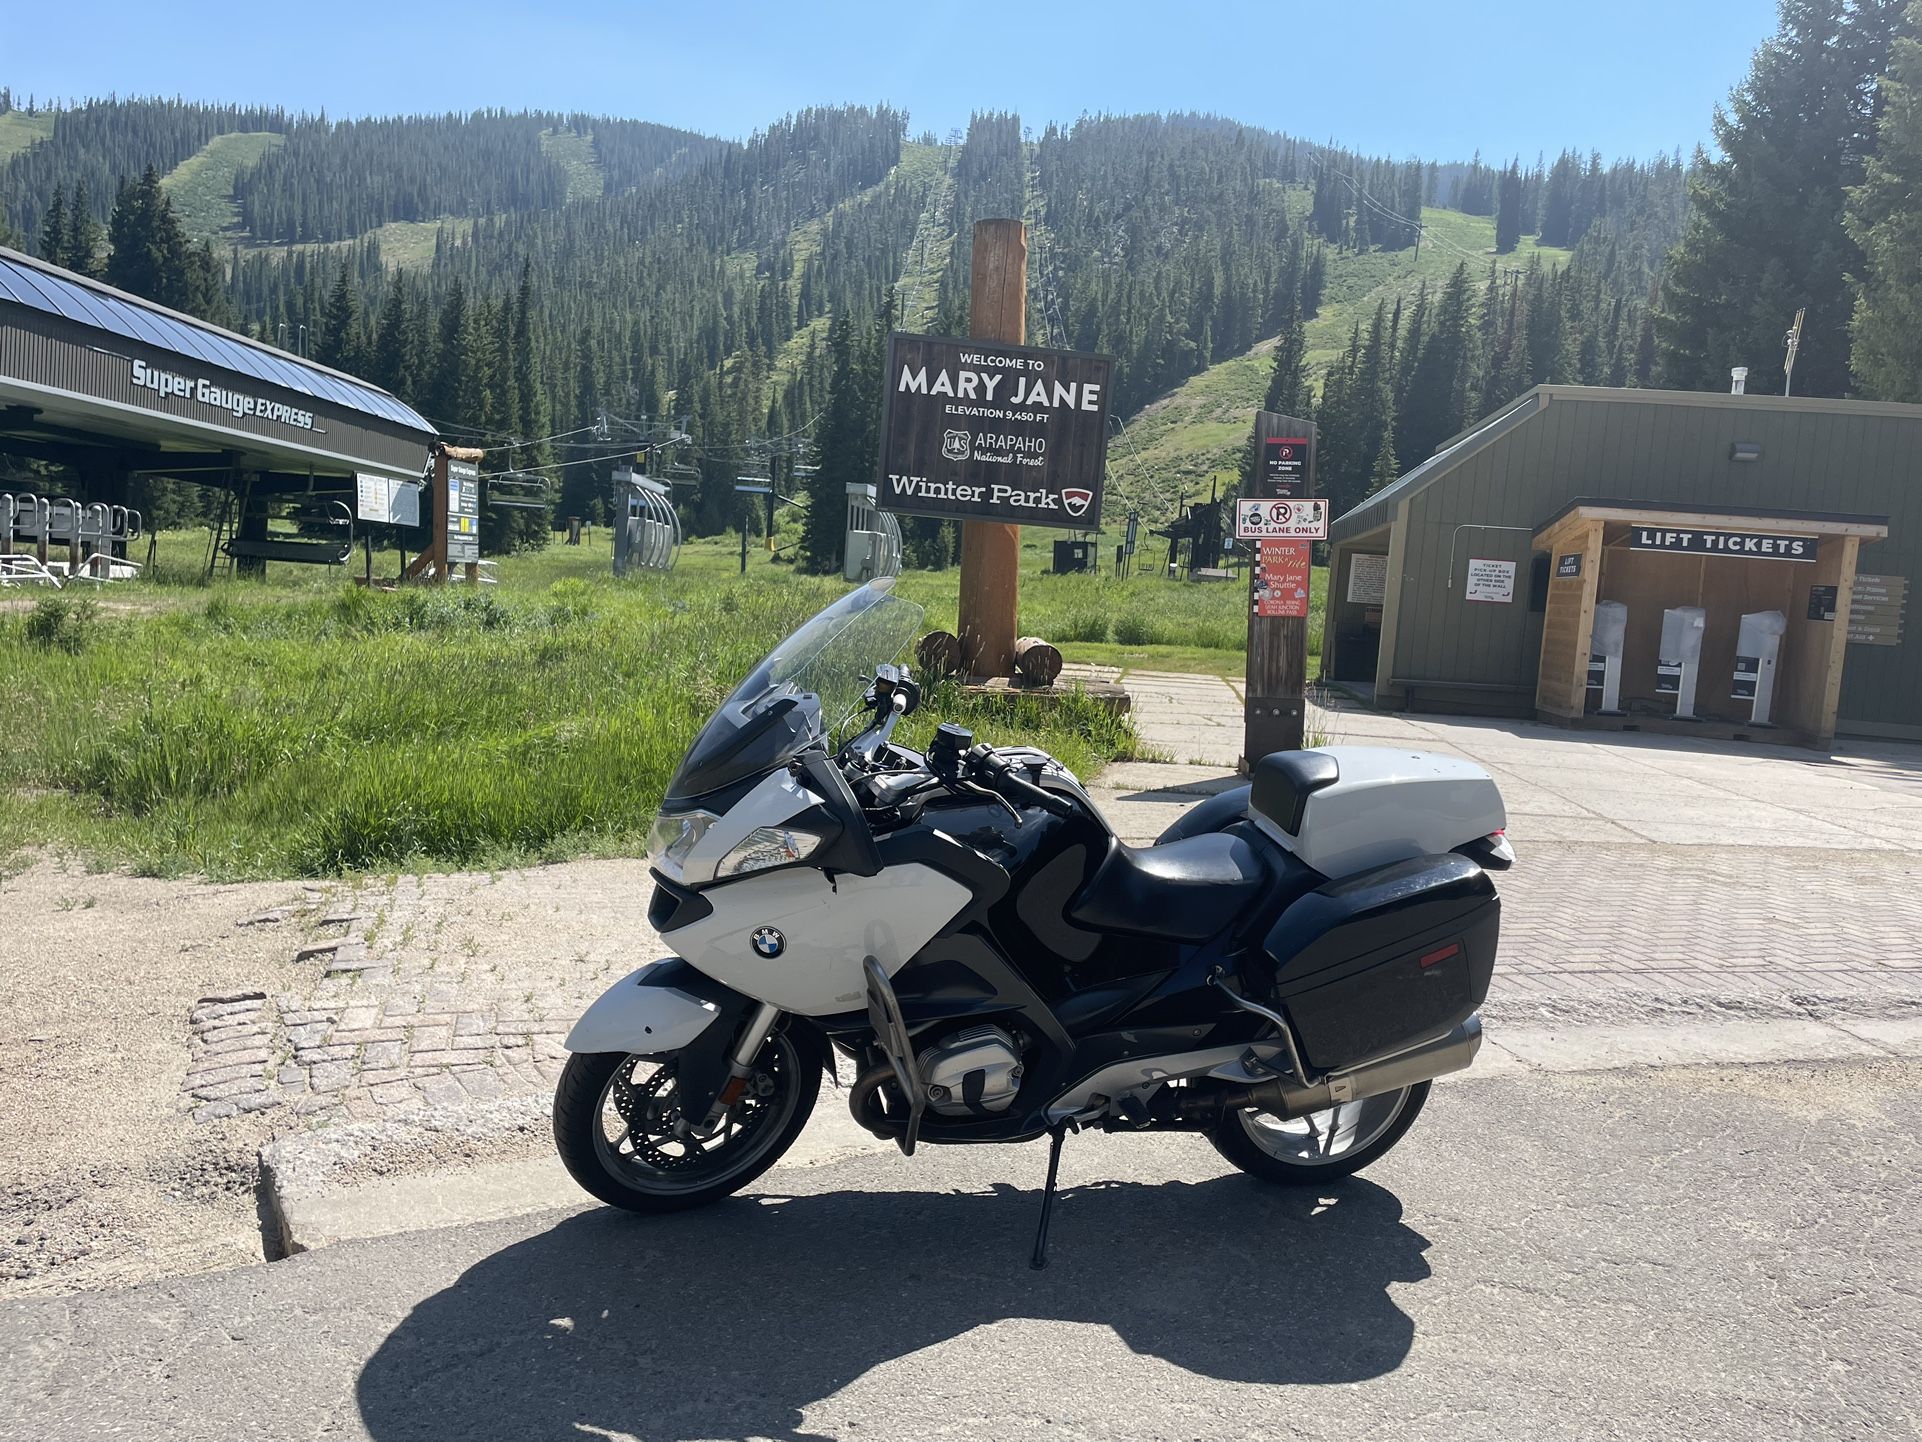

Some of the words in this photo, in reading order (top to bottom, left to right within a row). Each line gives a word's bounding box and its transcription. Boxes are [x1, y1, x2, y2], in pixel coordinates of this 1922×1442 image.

[960, 353, 1024, 369] WELCOME
[1027, 360, 1044, 371] TO
[132, 359, 195, 398] Super
[196, 378, 254, 418] Gauge
[255, 398, 314, 430] EXPRESS
[898, 364, 1003, 401] MARY
[1010, 376, 1101, 412] JANE
[945, 404, 1004, 419] ELEVATION
[1005, 411, 1033, 422] 9,450
[1036, 414, 1049, 423] FT
[975, 432, 1046, 453] ARAPAHO
[973, 450, 1014, 464] National
[1016, 454, 1045, 466] Forest
[888, 474, 986, 503] Winter
[989, 484, 1059, 510] Park
[1243, 526, 1263, 534] BUS
[1265, 526, 1291, 534] LANE
[1294, 526, 1321, 534] ONLY
[1262, 547, 1296, 555] WINTER
[1641, 530, 1693, 547] LIFT
[1703, 535, 1804, 555] TICKETS
[1262, 555, 1284, 564] PARK
[1287, 555, 1306, 569] ride
[1564, 557, 1575, 565] LIFT
[1265, 573, 1284, 583] Mary
[1286, 573, 1302, 582] Jane
[1270, 581, 1297, 589] Shuttle
